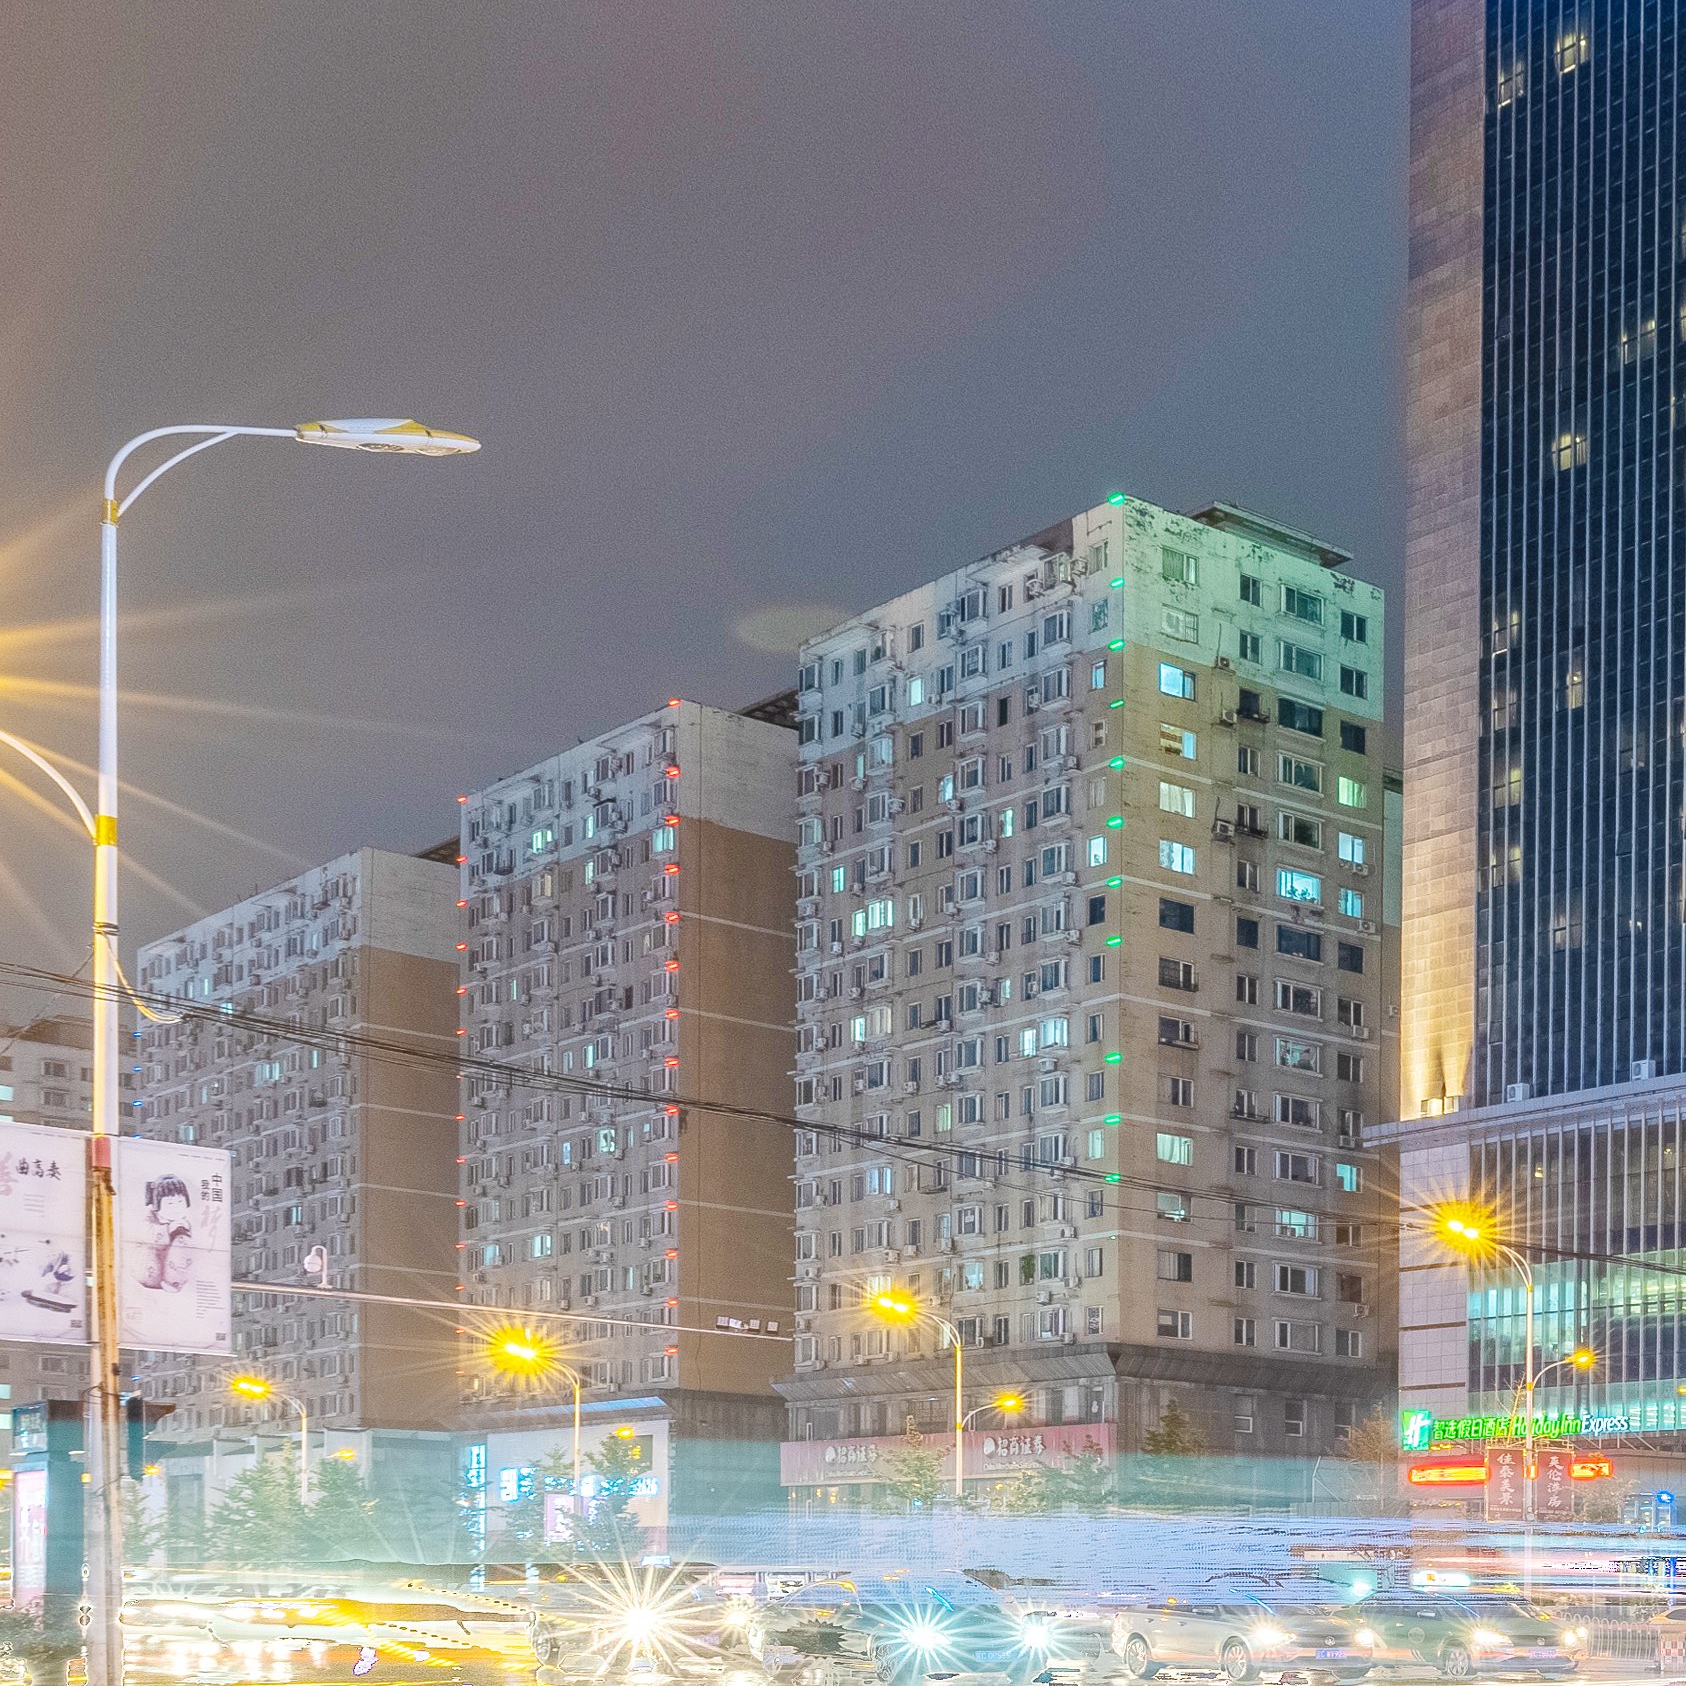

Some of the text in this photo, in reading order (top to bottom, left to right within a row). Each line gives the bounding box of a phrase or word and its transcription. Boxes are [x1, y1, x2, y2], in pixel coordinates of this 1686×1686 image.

[1432, 1412, 1629, 1440] 智选假日酒店 Hoiday Inn Express
[837, 1444, 878, 1464] 招商证券
[996, 1434, 1046, 1457] 招商证券
[1497, 1453, 1516, 1505] 佳泰美景
